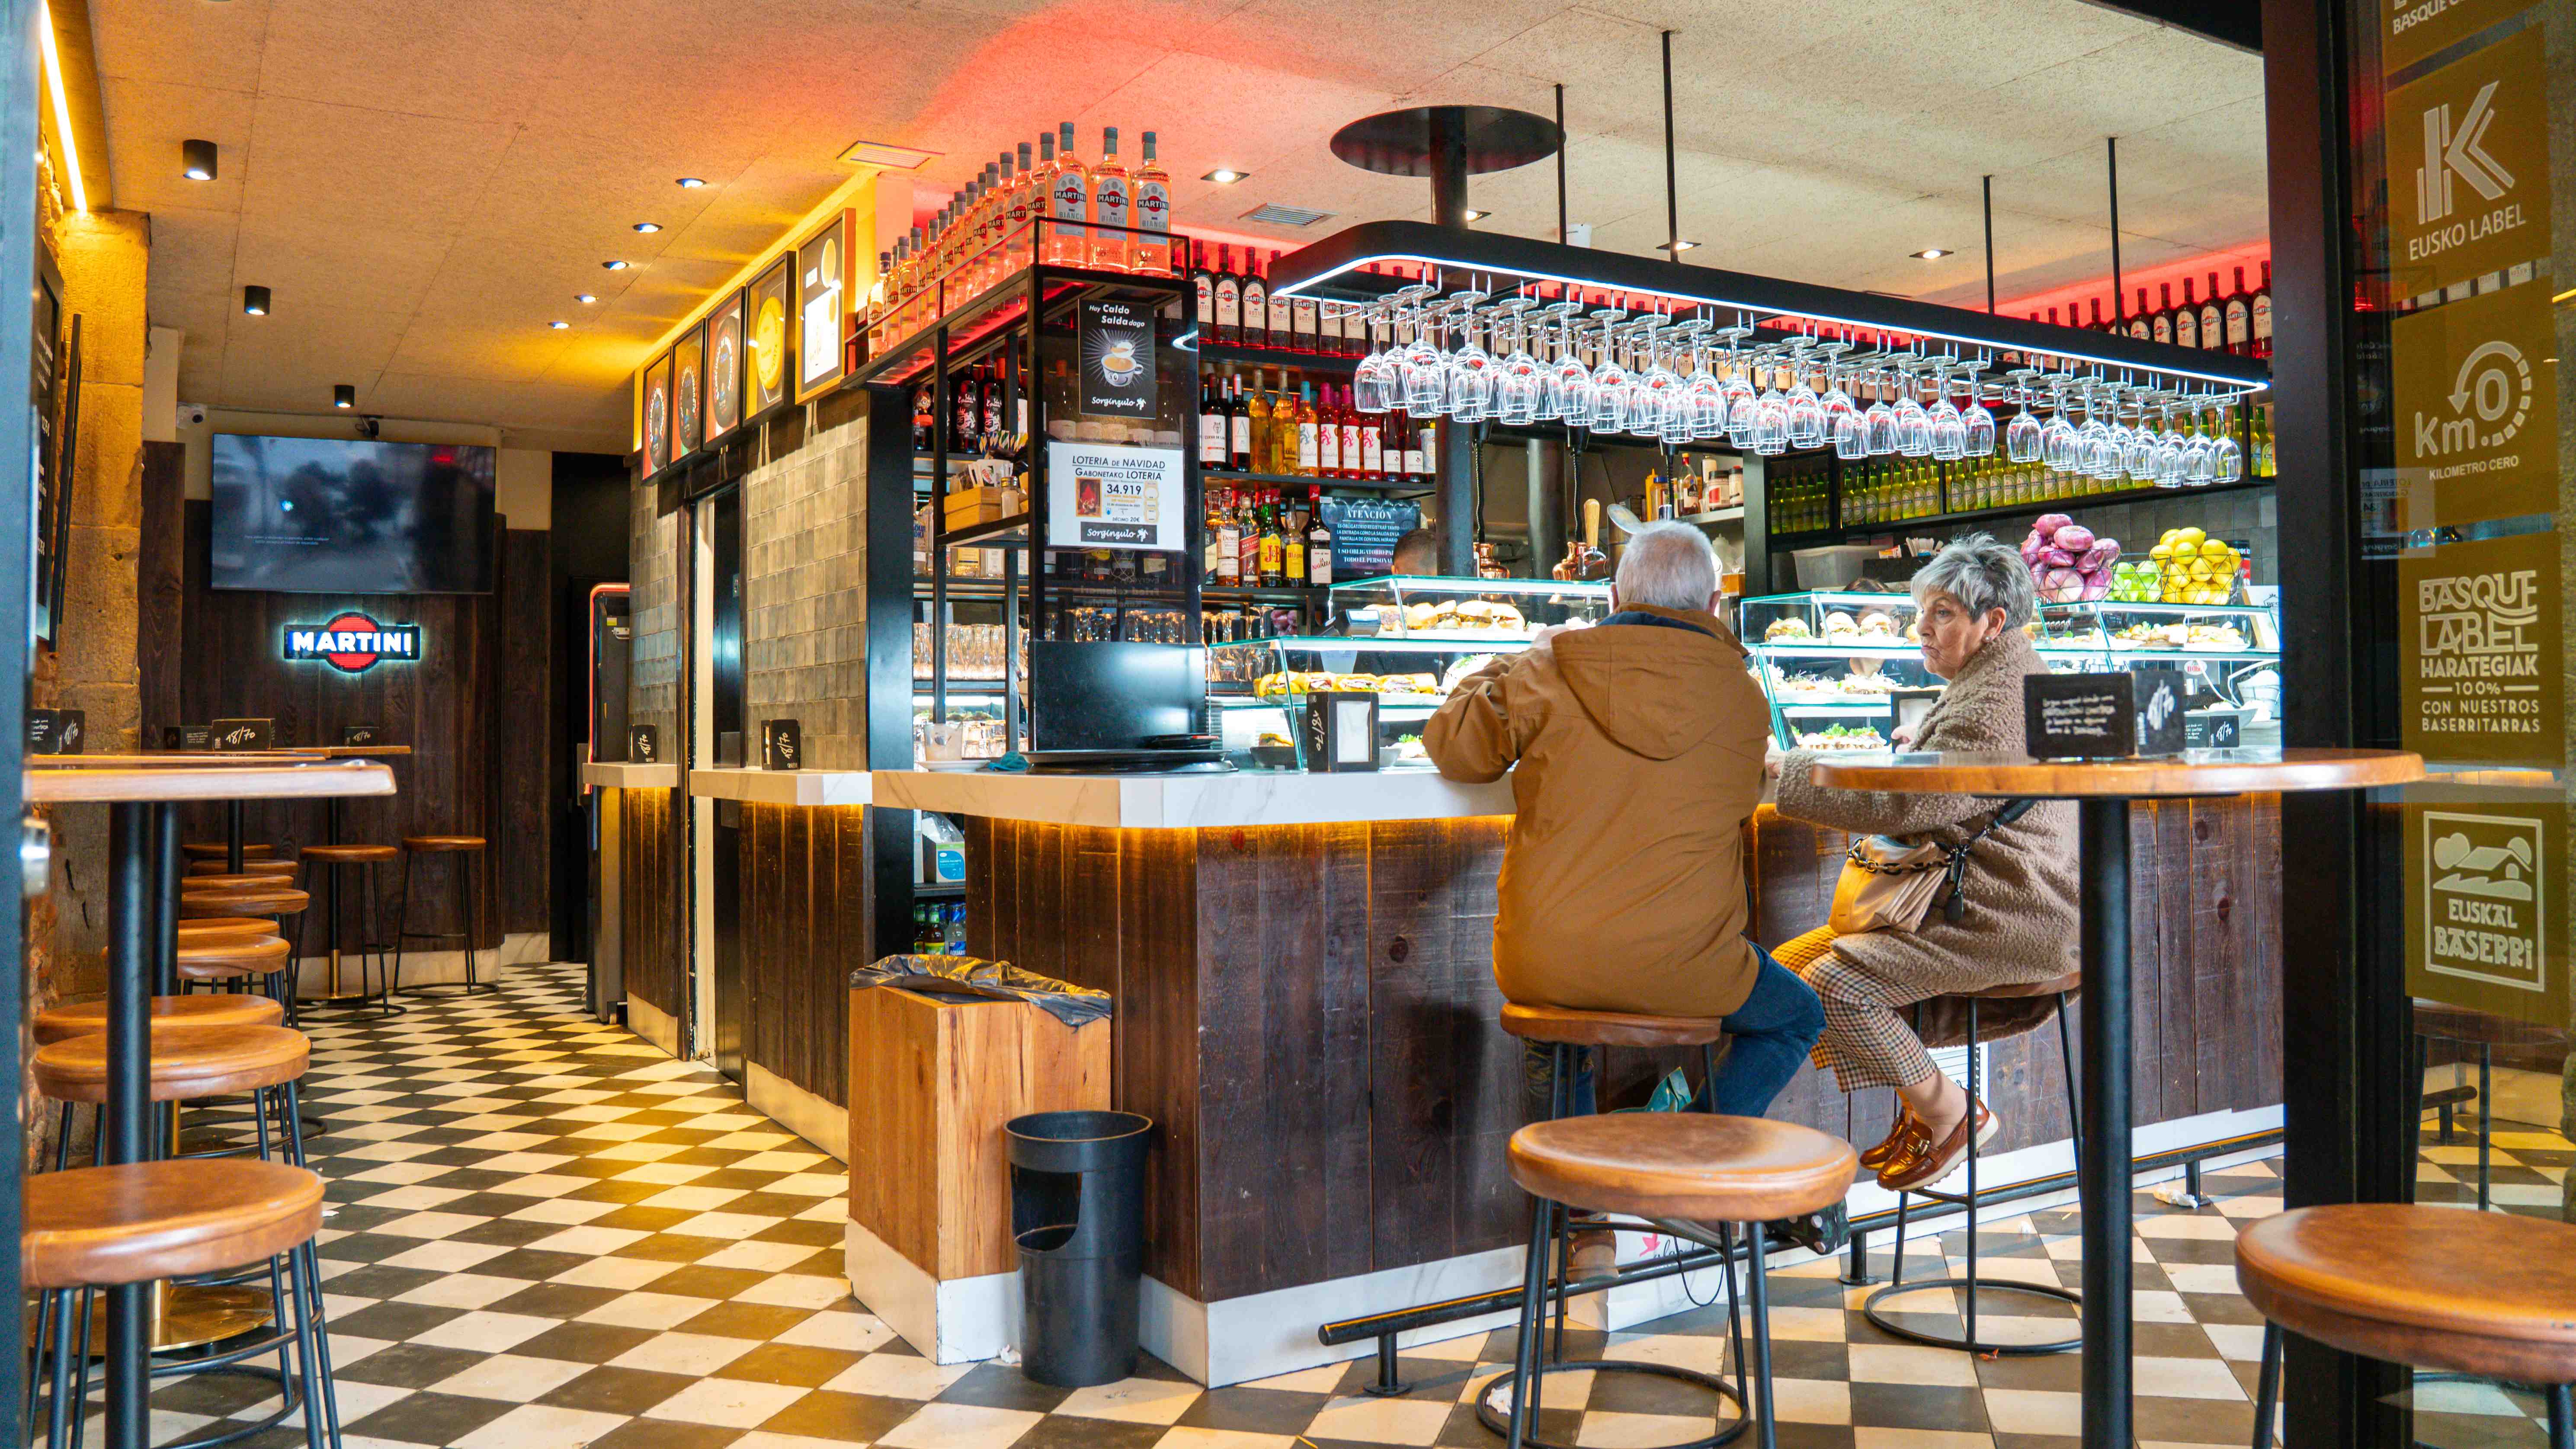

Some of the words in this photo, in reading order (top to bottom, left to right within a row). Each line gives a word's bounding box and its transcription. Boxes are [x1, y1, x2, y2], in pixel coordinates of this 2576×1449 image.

[2393, 0, 2447, 35] BASQUE
[1055, 191, 1086, 202] MARTINI
[1098, 195, 1128, 206] MARTINI
[1027, 202, 1045, 211] MART
[1138, 200, 1169, 211] MARTINI
[1006, 210, 1026, 219] MART
[988, 219, 1004, 228] MART
[2409, 224, 2465, 261] EUSKO
[2470, 204, 2526, 241] LABEL
[1198, 289, 1212, 297] ARTINI
[1102, 304, 1130, 314] Caldo
[1101, 316, 1128, 326] Salda
[1128, 318, 1145, 328] dago
[1072, 455, 1109, 466] LOTERIA
[1123, 459, 1166, 469] NAVIDAD
[2429, 461, 2486, 480] KILOMETRO
[2489, 455, 2519, 470] CERO
[1075, 468, 1124, 479] GABONETAKO
[1126, 470, 1162, 481] LOTERIA
[1107, 484, 1142, 495] 34.919
[1346, 509, 1391, 519] ATENCIÓN
[1312, 560, 1331, 571] NAVARRA
[2419, 570, 2538, 617] BASQUE
[2420, 611, 2538, 656] LABEL
[293, 631, 412, 653] MARTINI
[2421, 655, 2539, 678] HARATEGIAK
[2455, 681, 2501, 695] 100%
[2422, 700, 2451, 715] CON
[2460, 699, 2539, 715] NUESTROS
[2422, 717, 2541, 733] BASERRITARRAS
[225, 726, 256, 745] 18/70
[2448, 898, 2518, 929] EUSKAL
